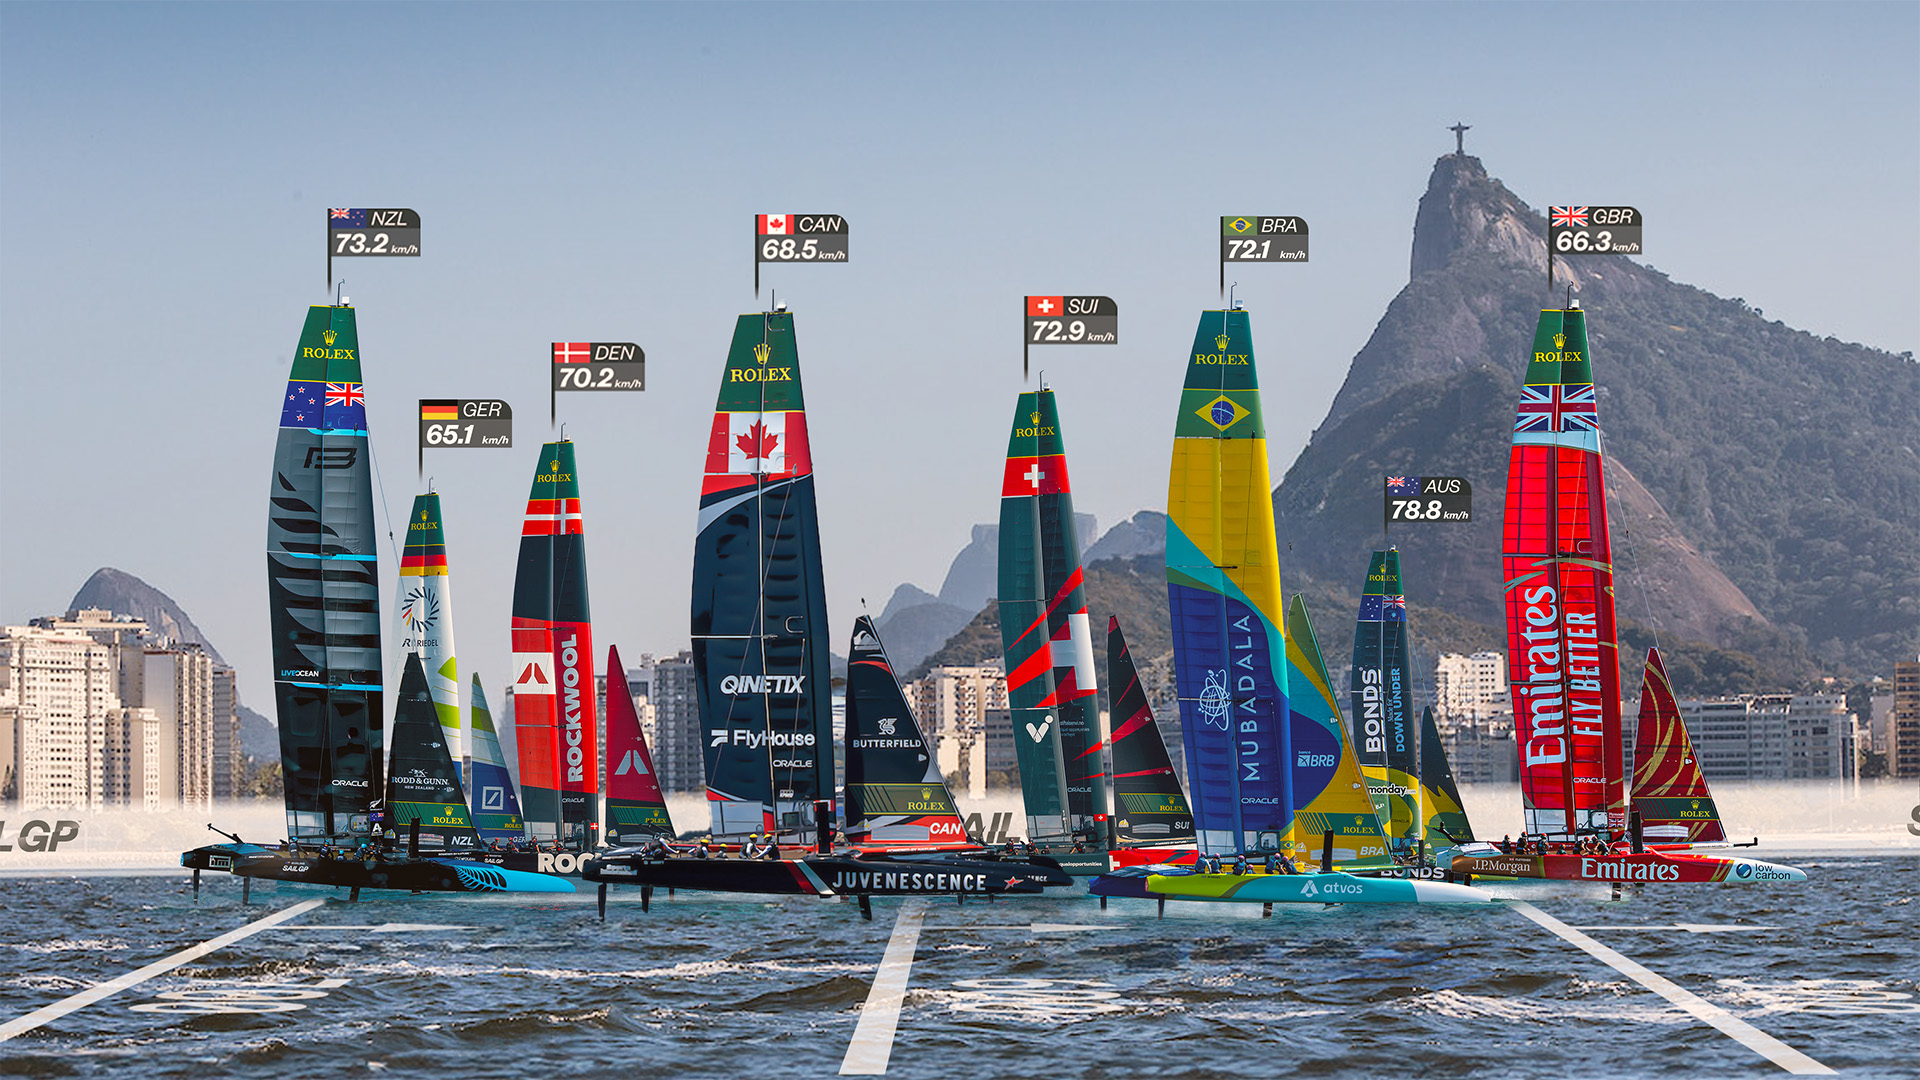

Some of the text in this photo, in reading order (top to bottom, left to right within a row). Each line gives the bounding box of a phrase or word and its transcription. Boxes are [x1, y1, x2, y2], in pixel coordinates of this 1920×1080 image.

[303, 347, 355, 360] ROLEX
[1534, 351, 1582, 362] ROLEX
[1195, 354, 1249, 365] ROLEX
[730, 367, 792, 382] ROLEX
[1016, 426, 1055, 437] ROLEX
[537, 473, 572, 483] ROLEX
[411, 521, 438, 531] ROLEX
[1369, 574, 1398, 582] ROLEX
[417, 639, 439, 647] RIEDEL
[1520, 585, 1567, 768] Emirates
[1566, 612, 1602, 737] FLY BETTER
[720, 675, 806, 696] QINETIX
[1233, 614, 1261, 782] MUBADALA
[561, 633, 584, 782] ROCKWOOL
[1361, 667, 1382, 753] BONDS
[1391, 667, 1406, 752] DOWN UNDER
[733, 729, 816, 749] FlyHouse
[853, 739, 922, 748] BUTTERFIELD
[773, 759, 813, 768] ORACLE
[1310, 754, 1335, 767] BRB
[331, 779, 369, 788] ORACLE
[391, 776, 416, 784] RODD
[908, 801, 945, 811] ROLEX
[1240, 797, 1279, 805] ORACLE
[1680, 810, 1711, 818] ROLEX
[432, 816, 464, 825] ROLEX
[1174, 821, 1190, 830] SUI
[929, 822, 961, 835] CAN
[1343, 826, 1375, 834] ROLEX
[450, 835, 474, 846] NZL
[1360, 846, 1385, 856] BRA
[538, 853, 588, 874] ROC
[1581, 857, 1680, 881] Emirates
[1755, 863, 1773, 871] low
[1380, 867, 1445, 879] BONDS
[1755, 871, 1791, 880] carbon
[832, 871, 987, 891] JUVENESCENCE
[1323, 882, 1363, 894] atvos
